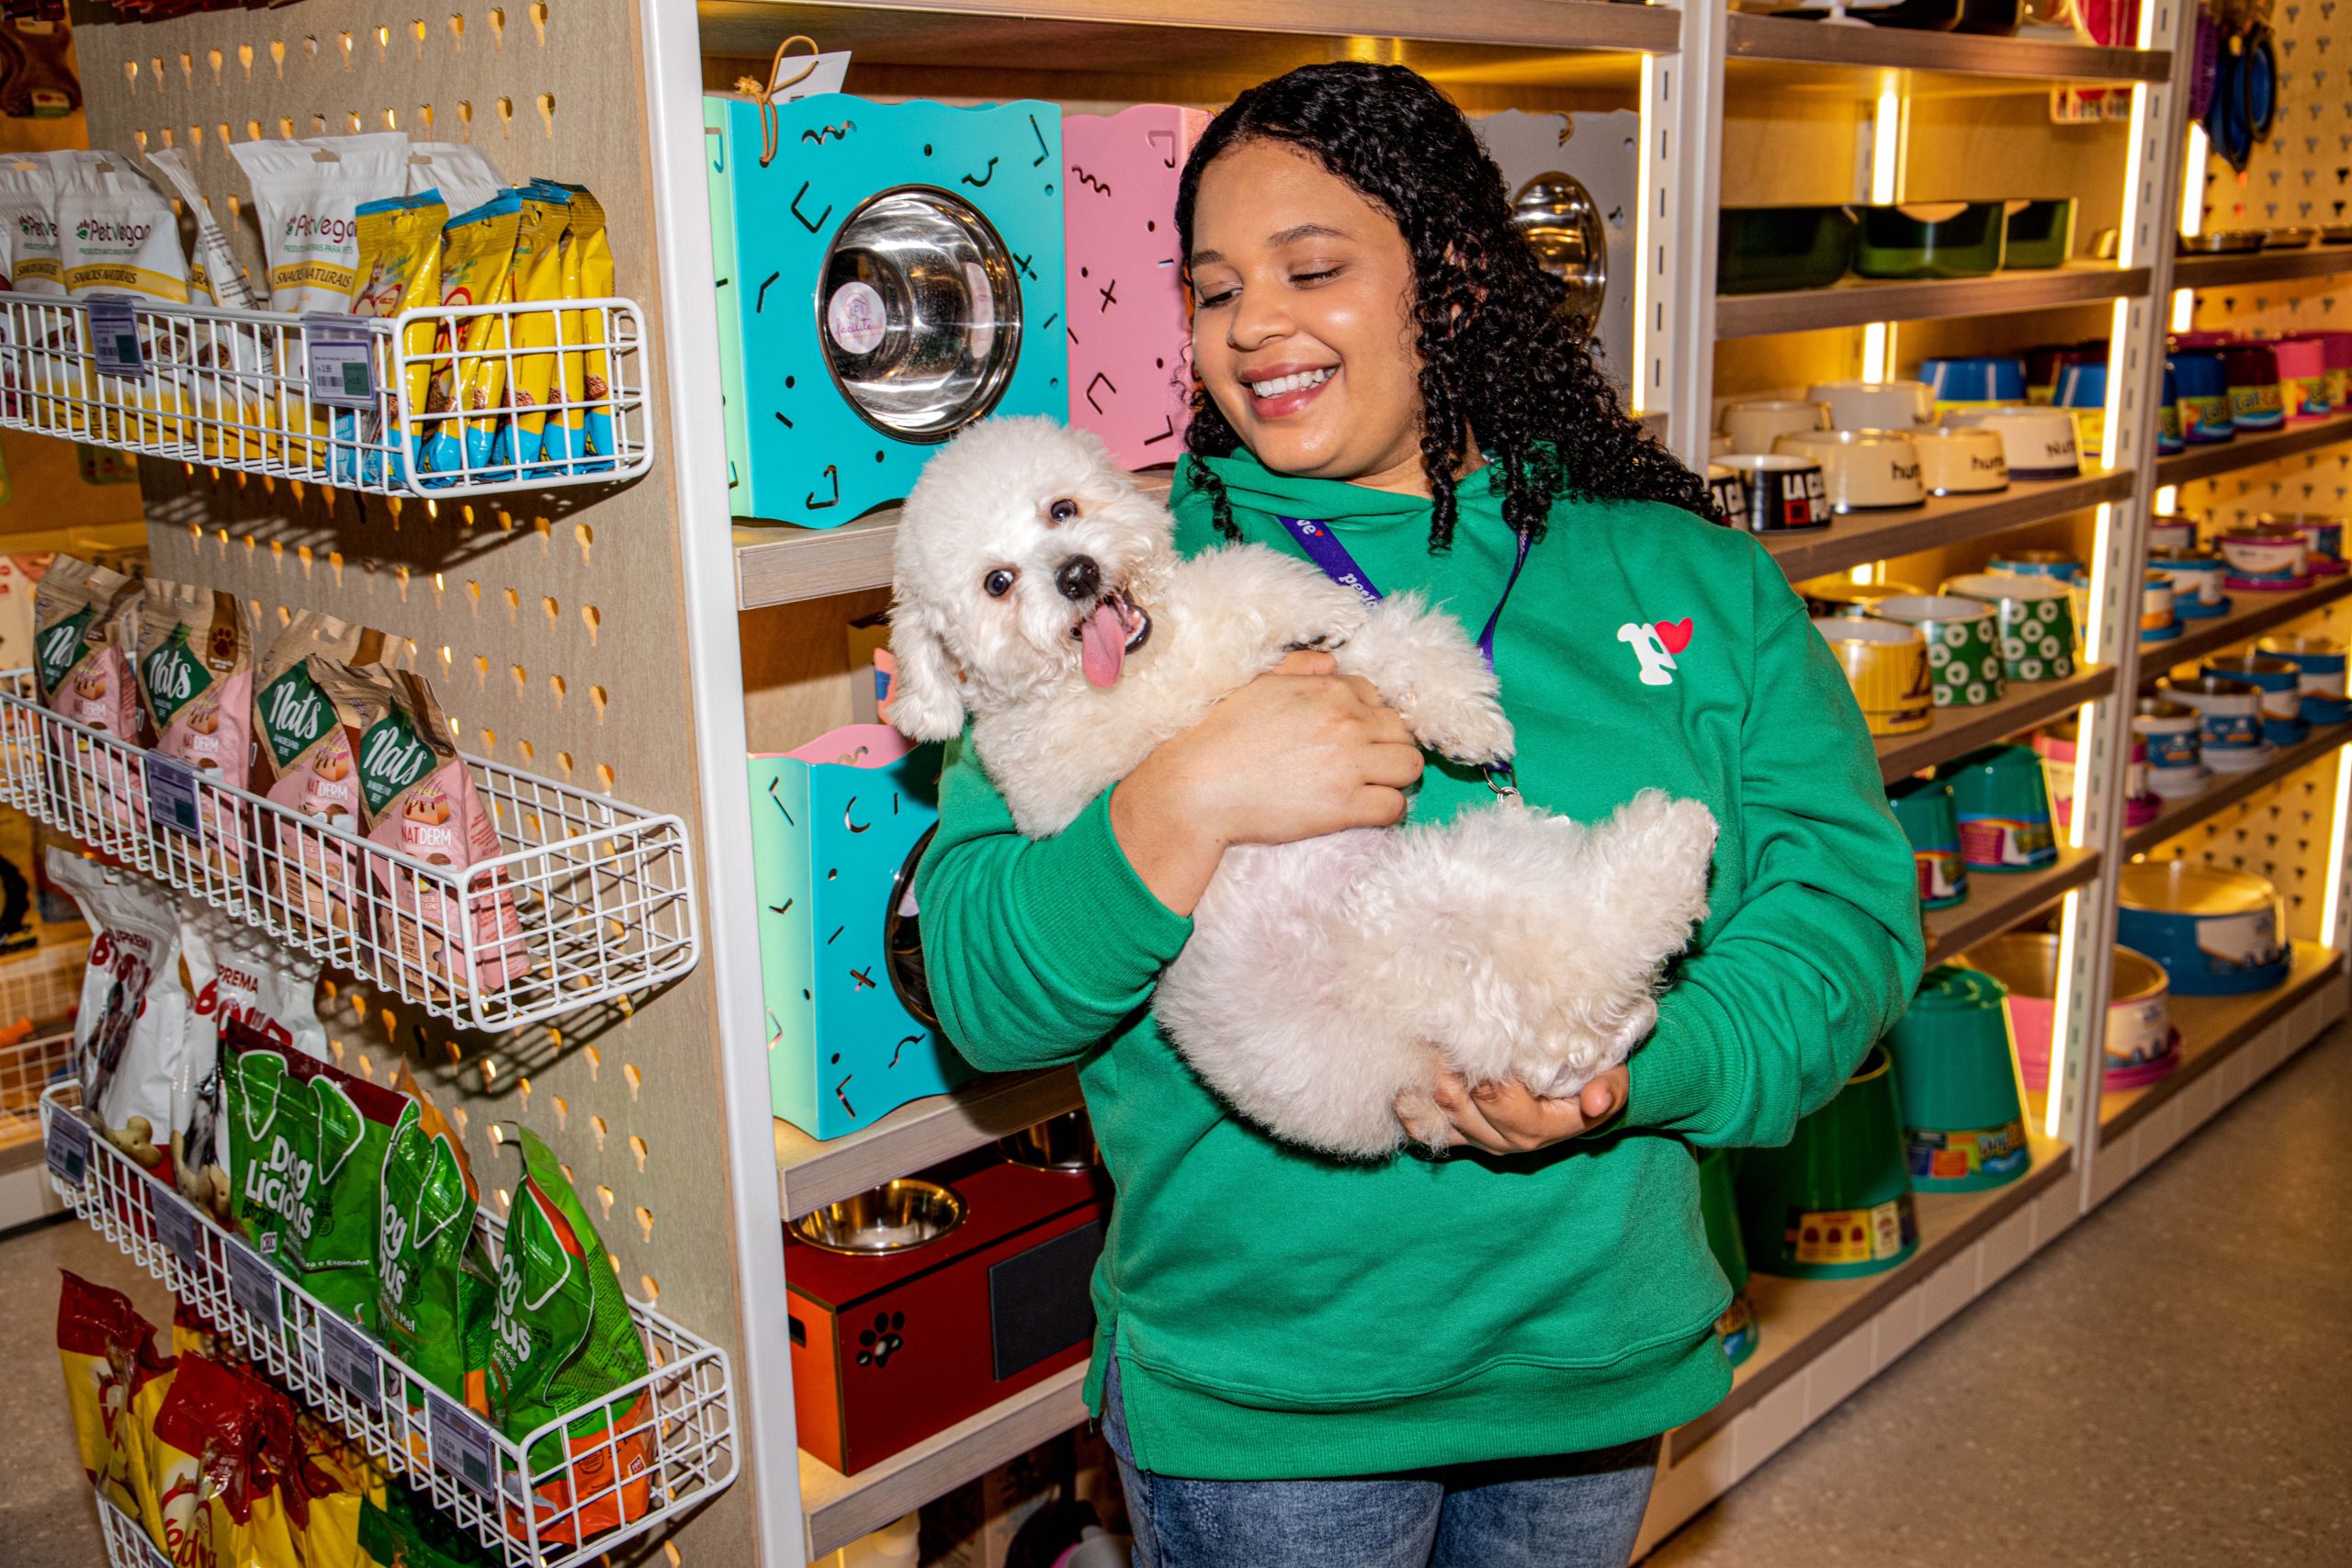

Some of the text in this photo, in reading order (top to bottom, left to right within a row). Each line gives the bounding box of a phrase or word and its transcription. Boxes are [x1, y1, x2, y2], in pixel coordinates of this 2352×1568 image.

[149, 649, 192, 699] Nats
[268, 681, 322, 739] Nats
[362, 726, 428, 785] Nats
[401, 826, 453, 846] NATDERM
[269, 1134, 314, 1201] Dog
[244, 1158, 315, 1240] Licious
[326, 1258, 370, 1268] Espinafre
